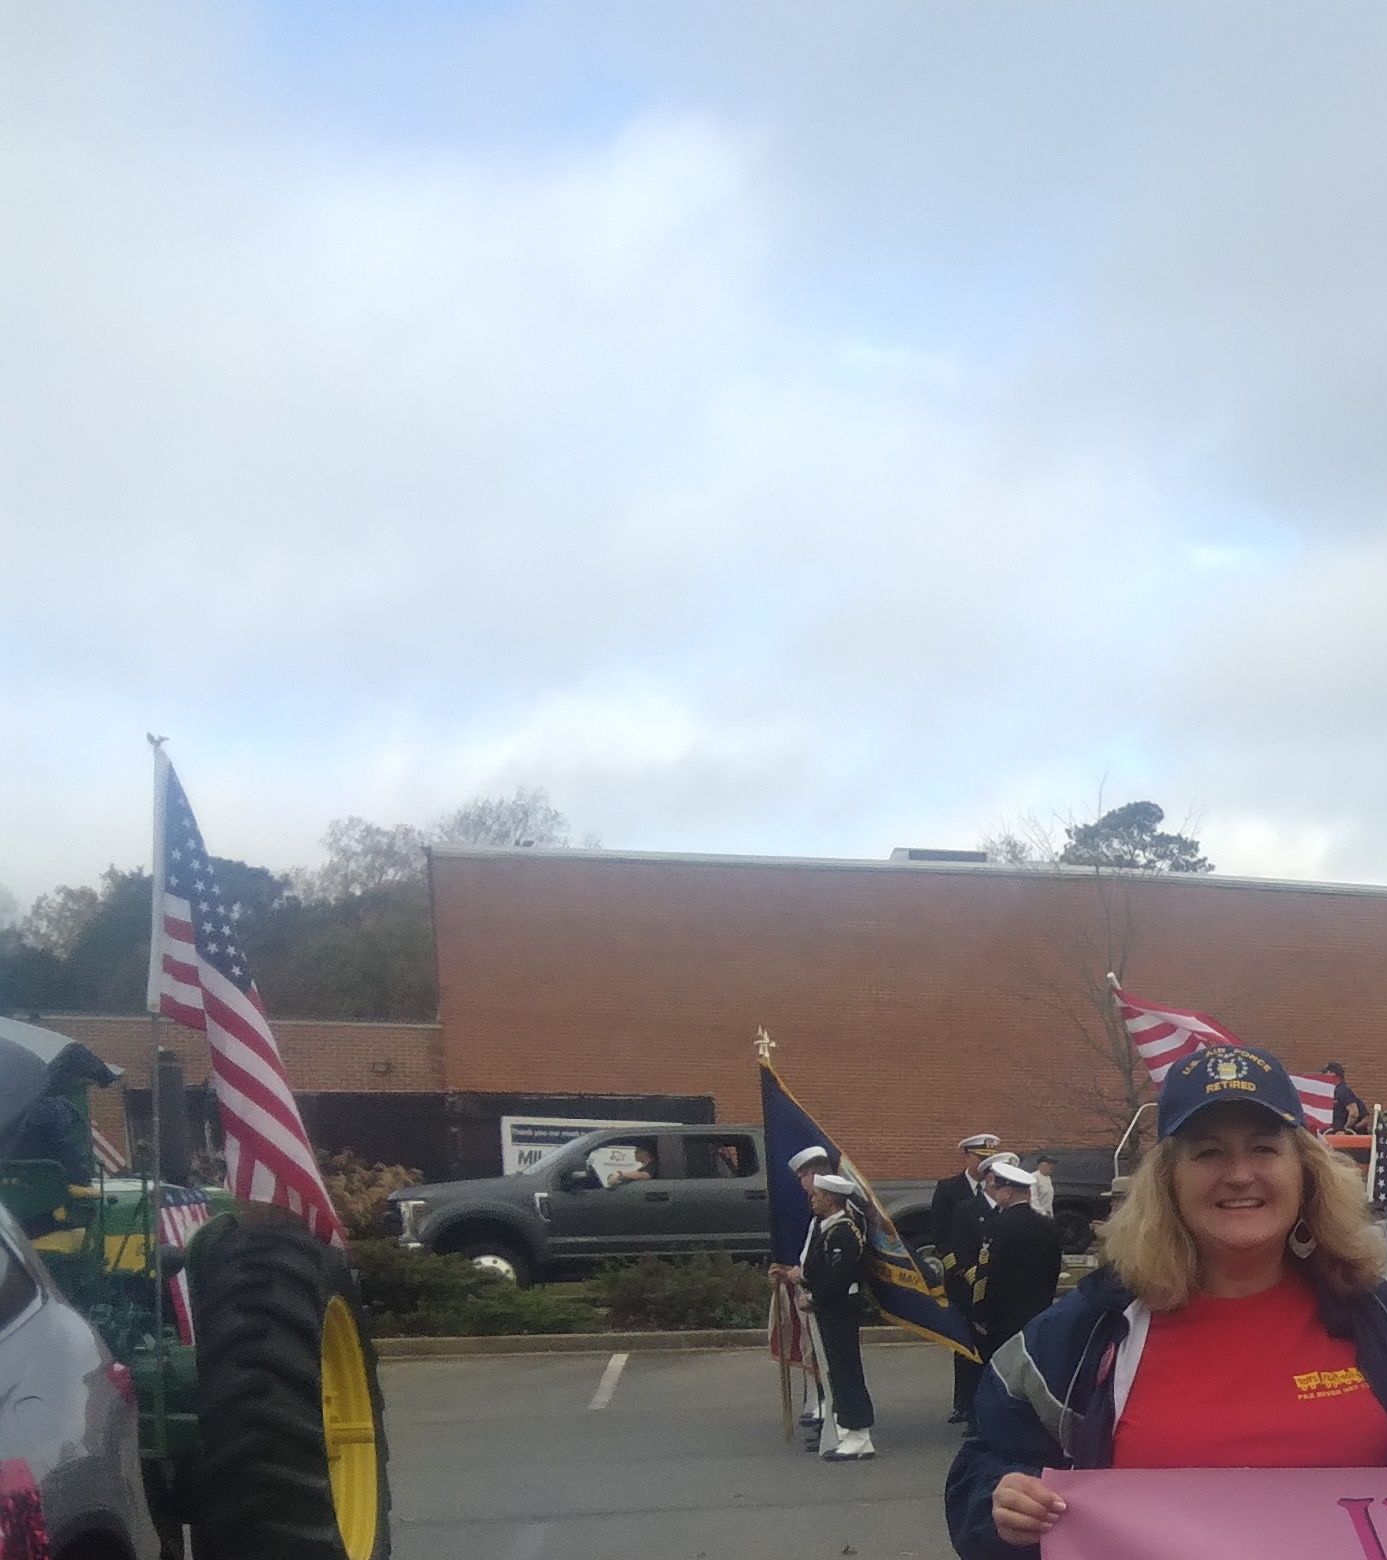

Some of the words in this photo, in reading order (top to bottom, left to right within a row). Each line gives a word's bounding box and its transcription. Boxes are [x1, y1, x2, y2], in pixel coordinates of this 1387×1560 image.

[1205, 1047, 1226, 1058] AIR
[1234, 1048, 1272, 1073] FORCE
[1206, 1080, 1256, 1094] RETIRED
